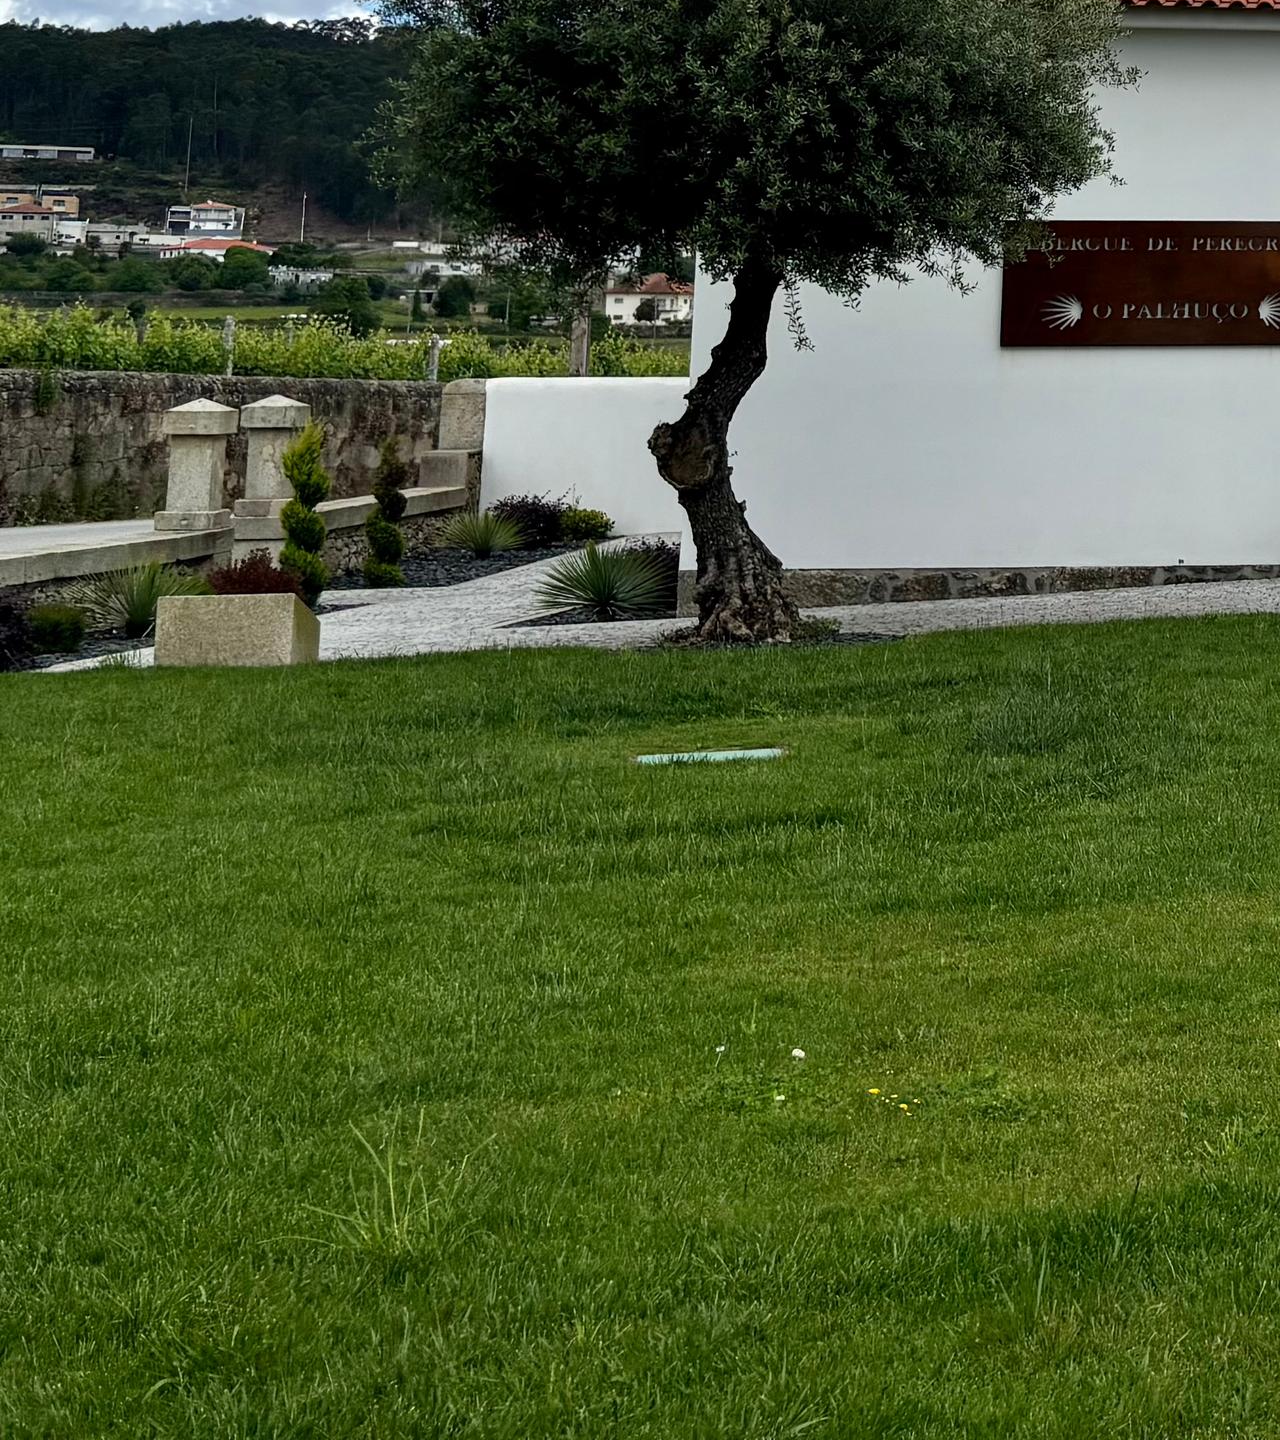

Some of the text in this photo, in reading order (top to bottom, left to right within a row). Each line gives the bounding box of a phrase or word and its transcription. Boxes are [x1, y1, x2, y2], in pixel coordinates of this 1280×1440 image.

[1146, 237, 1179, 252] DE
[1092, 302, 1249, 324] O PALHUÇO
